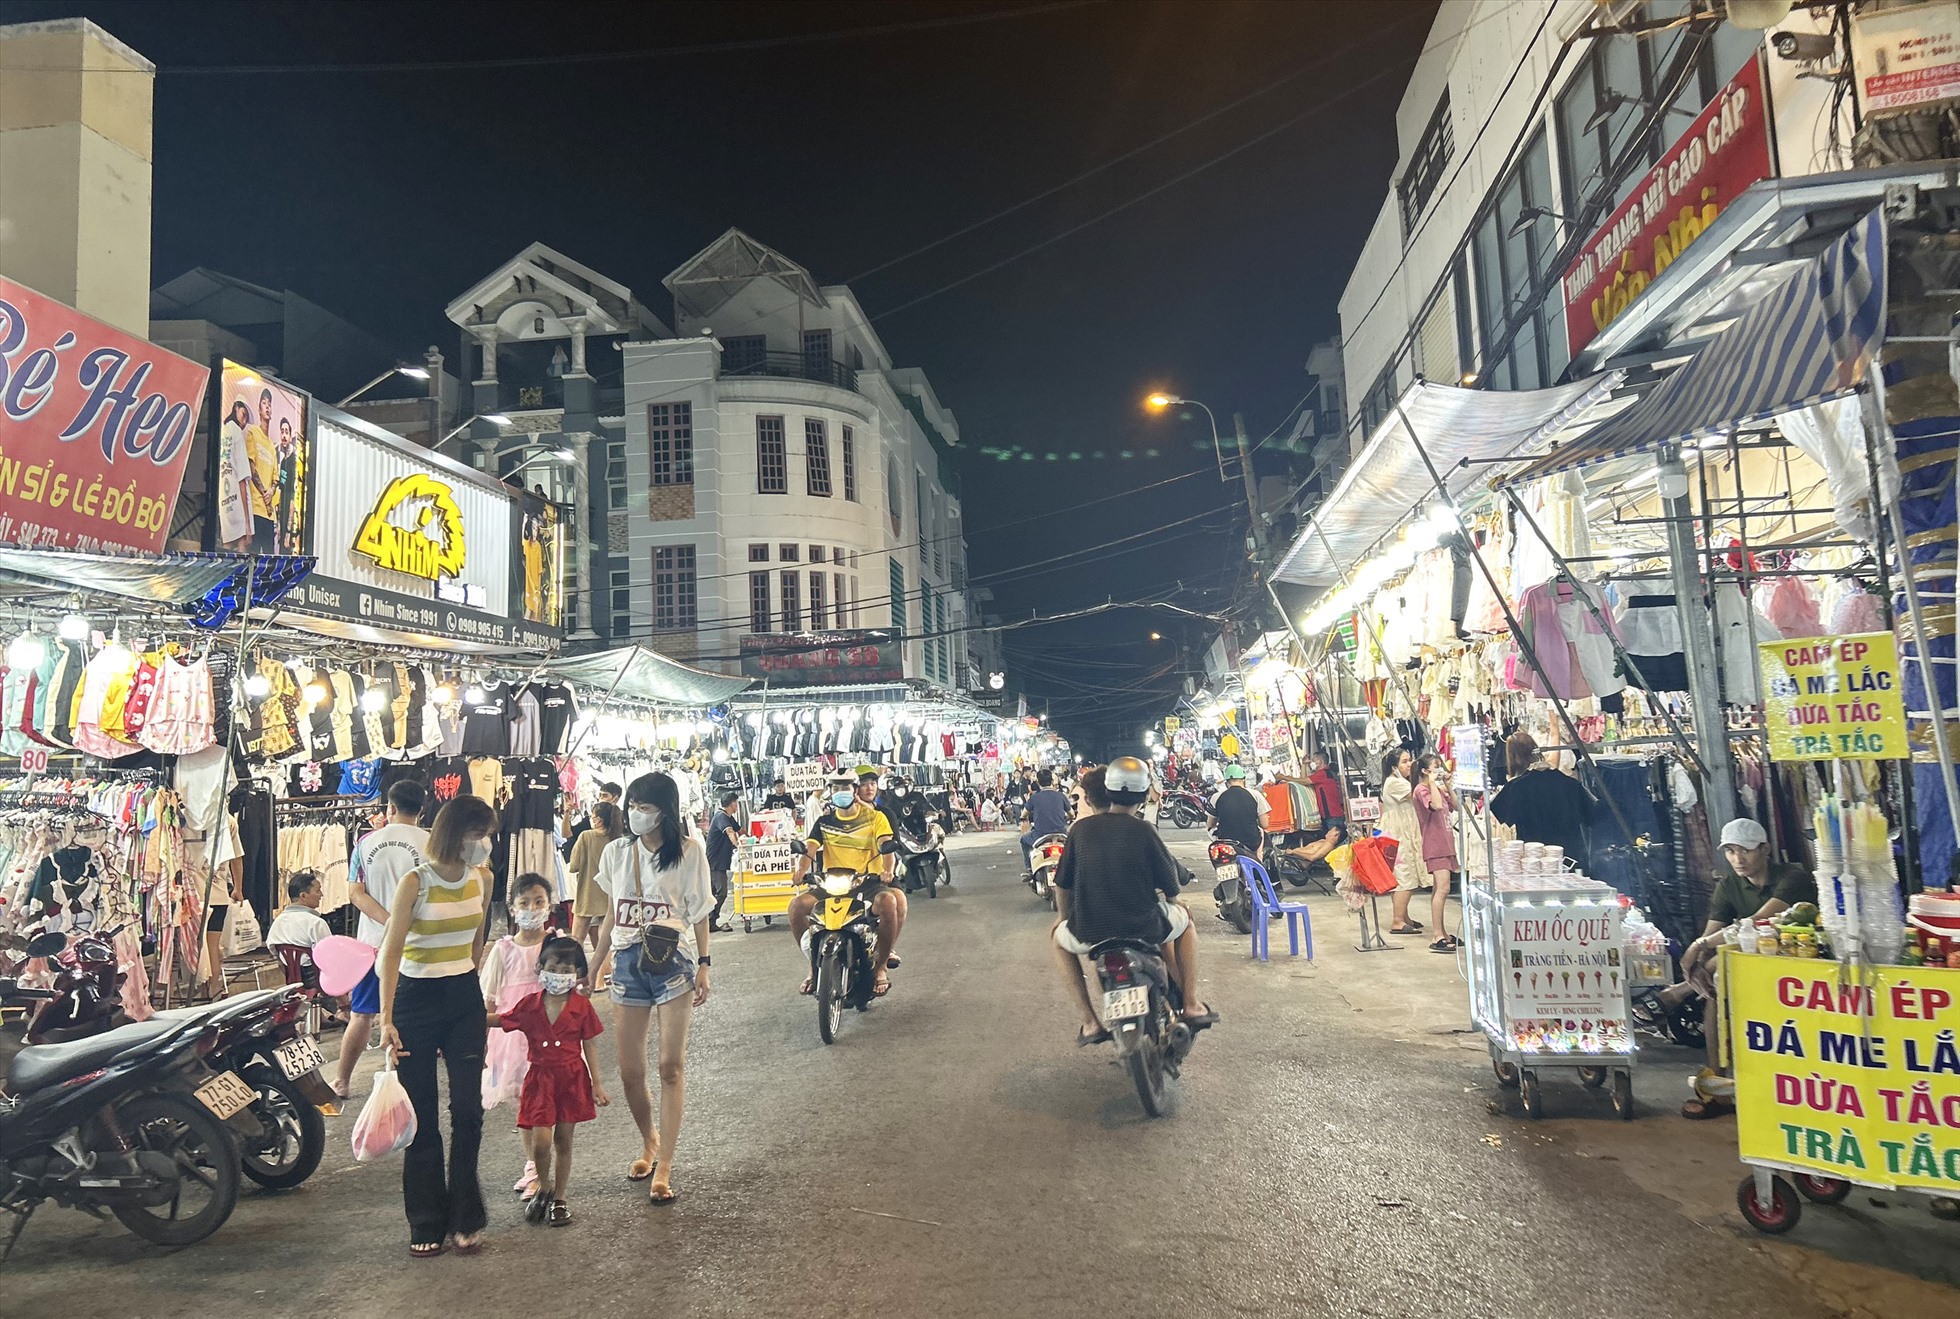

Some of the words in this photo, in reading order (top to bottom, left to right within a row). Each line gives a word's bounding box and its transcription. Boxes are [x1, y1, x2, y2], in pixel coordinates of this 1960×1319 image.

[1565, 252, 1596, 304] THỜI
[1595, 203, 1642, 273] TRANG
[1642, 167, 1668, 224] NỮ
[1667, 136, 1705, 196] CAO
[1706, 82, 1749, 154] CẤP
[58, 346, 192, 466] Heo
[19, 459, 54, 504] SỈ
[50, 473, 70, 508] &
[72, 473, 104, 517] LẺ
[100, 479, 137, 525] ĐỒ
[134, 493, 167, 540] BỘ
[37, 527, 59, 547] 373
[309, 584, 341, 608] Unisex
[373, 598, 395, 618] Nhím
[396, 603, 419, 623] Since
[419, 608, 438, 627] 1991
[458, 617, 476, 634] 0908
[477, 621, 491, 637] 905
[491, 624, 504, 639] 415
[1785, 644, 1832, 666] CAM
[1840, 639, 1869, 663] ÉP
[1808, 674, 1840, 695] ME
[1847, 665, 1892, 692] LẮC
[1788, 702, 1830, 725] DỪA
[1836, 697, 1882, 723] TẮC
[1792, 732, 1832, 755] TRÀ
[1838, 727, 1884, 753] TẮC
[22, 751, 46, 771] 80
[754, 848, 771, 859] DỪA
[754, 861, 767, 872] CÀ
[771, 859, 790, 872] PHÊ
[1513, 920, 1547, 942] KEM
[1551, 909, 1574, 942] ỐC
[1577, 908, 1611, 947] QUẾ
[1524, 951, 1552, 967] TRÀNG
[1553, 949, 1574, 966] TIỀN
[1579, 951, 1591, 966] HÀ
[1777, 976, 1876, 1018] CAM
[1891, 981, 1952, 1021] ÉP
[280, 1038, 312, 1063] 78-F1
[1746, 1019, 1805, 1059] ĐÁ
[1819, 1030, 1888, 1070] ME
[286, 1050, 323, 1077] 452.38
[202, 1077, 237, 1102] 77-G1
[212, 1086, 251, 1117] 750.40
[1775, 1071, 1865, 1118] DỪA
[1779, 1123, 1867, 1170] TRÀ
